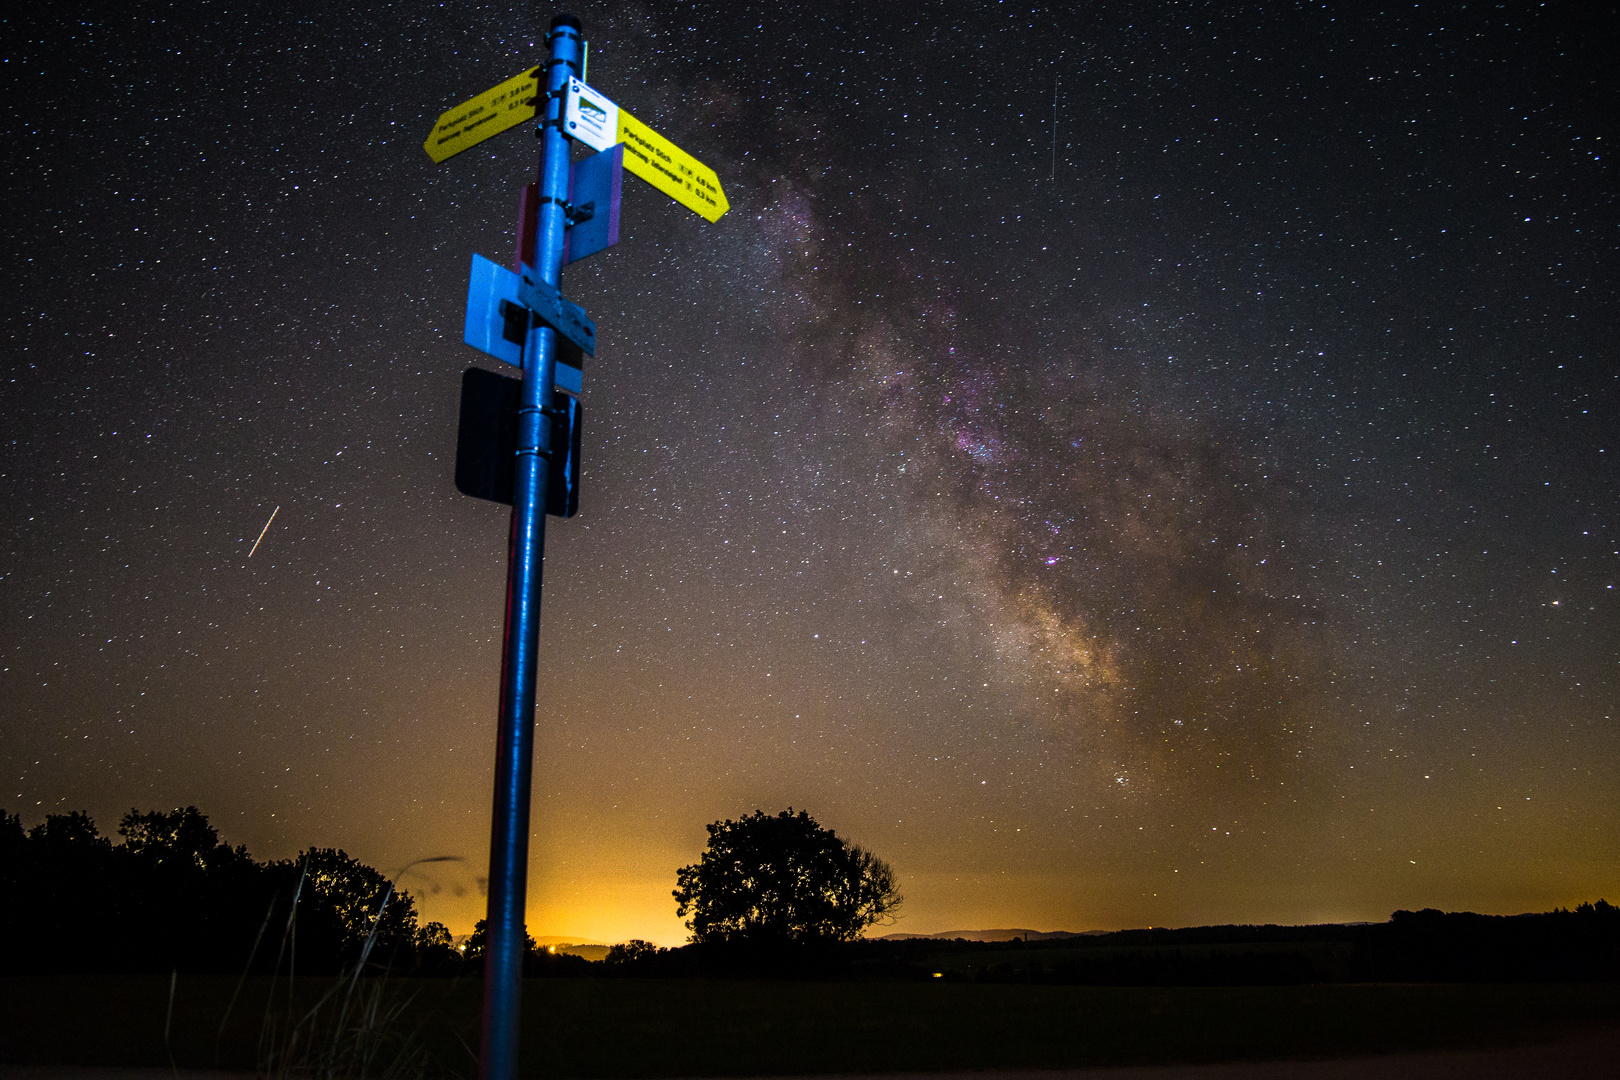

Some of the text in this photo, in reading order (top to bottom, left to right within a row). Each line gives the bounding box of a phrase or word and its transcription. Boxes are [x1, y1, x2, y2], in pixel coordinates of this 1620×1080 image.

[521, 83, 532, 92] km
[623, 126, 655, 153] Parkplatz
[655, 148, 672, 164] Stich
[706, 181, 717, 194] km
[706, 194, 717, 207] km
